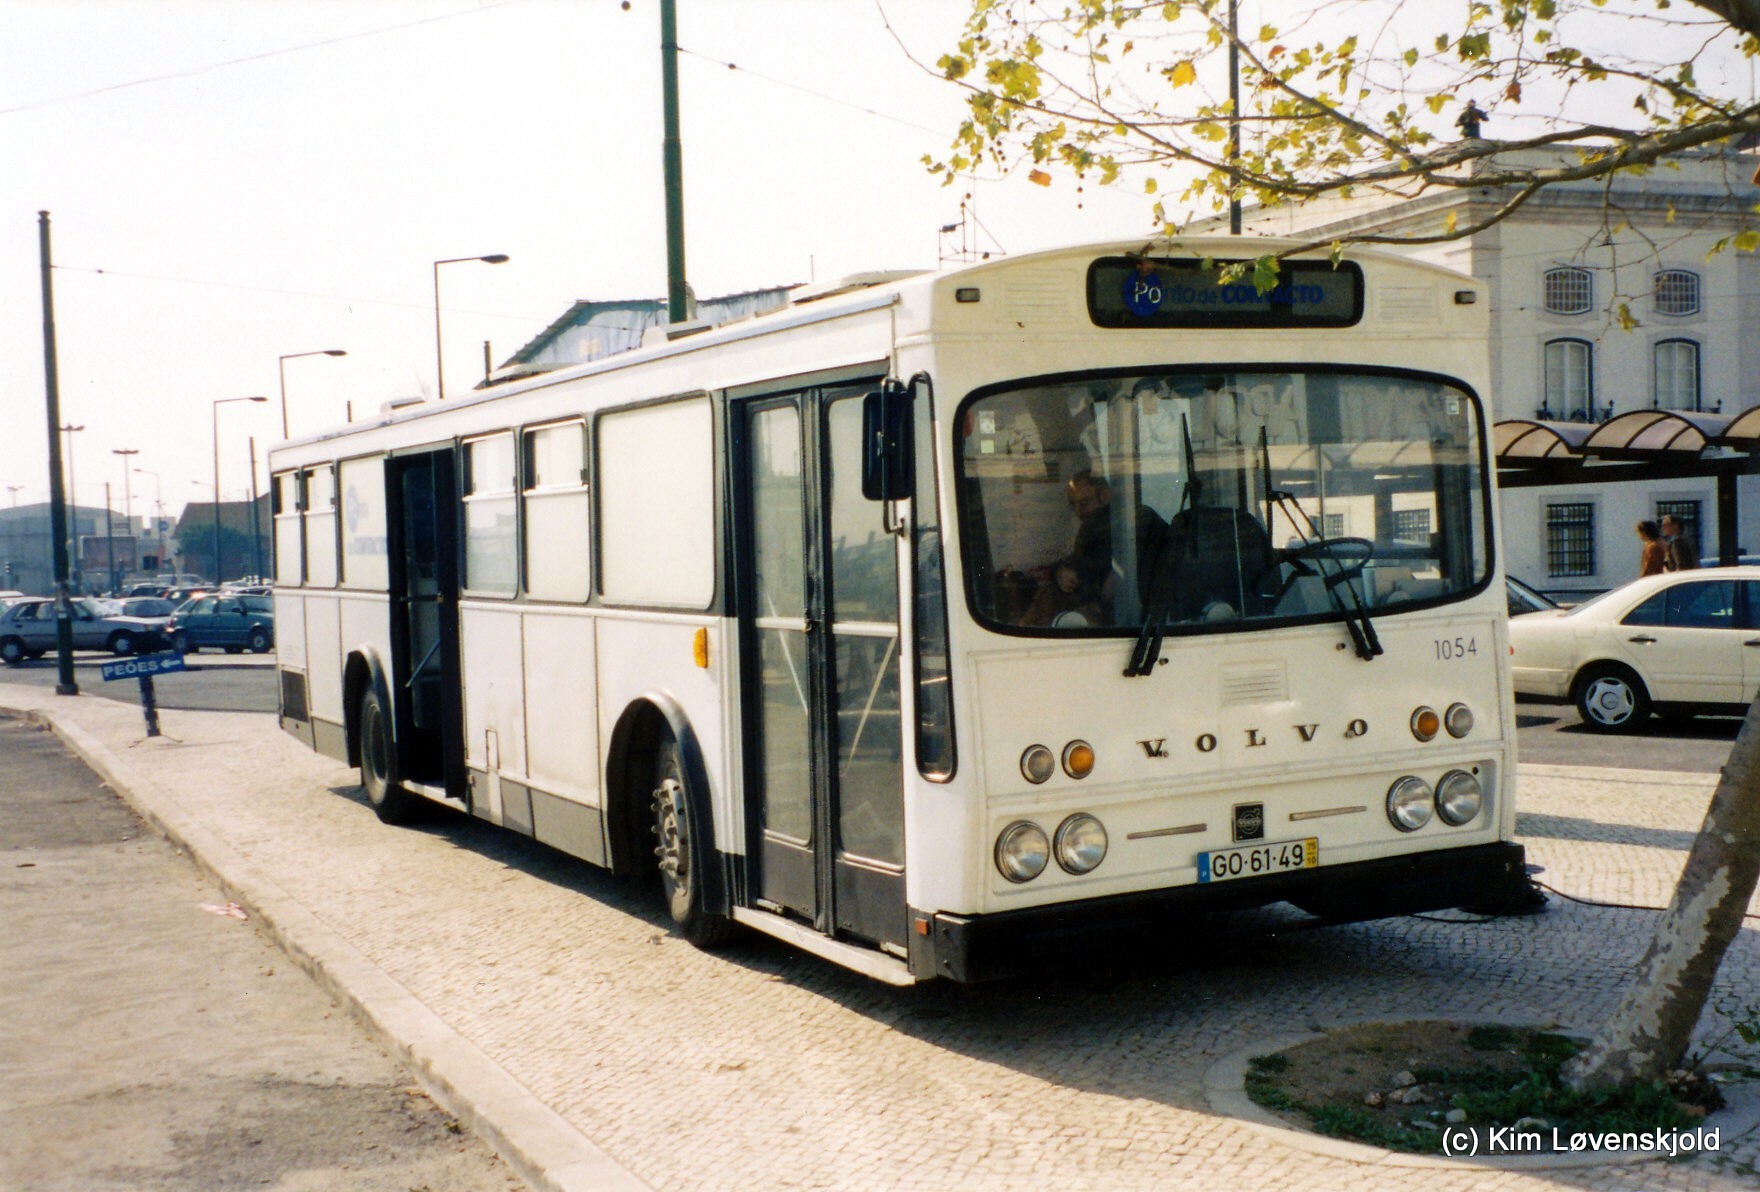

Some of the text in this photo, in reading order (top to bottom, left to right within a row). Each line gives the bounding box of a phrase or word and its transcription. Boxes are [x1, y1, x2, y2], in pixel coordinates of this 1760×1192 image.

[1434, 637, 1477, 660] 1054
[103, 660, 159, 677] PEÕES
[1136, 718, 1369, 759] VOLVO
